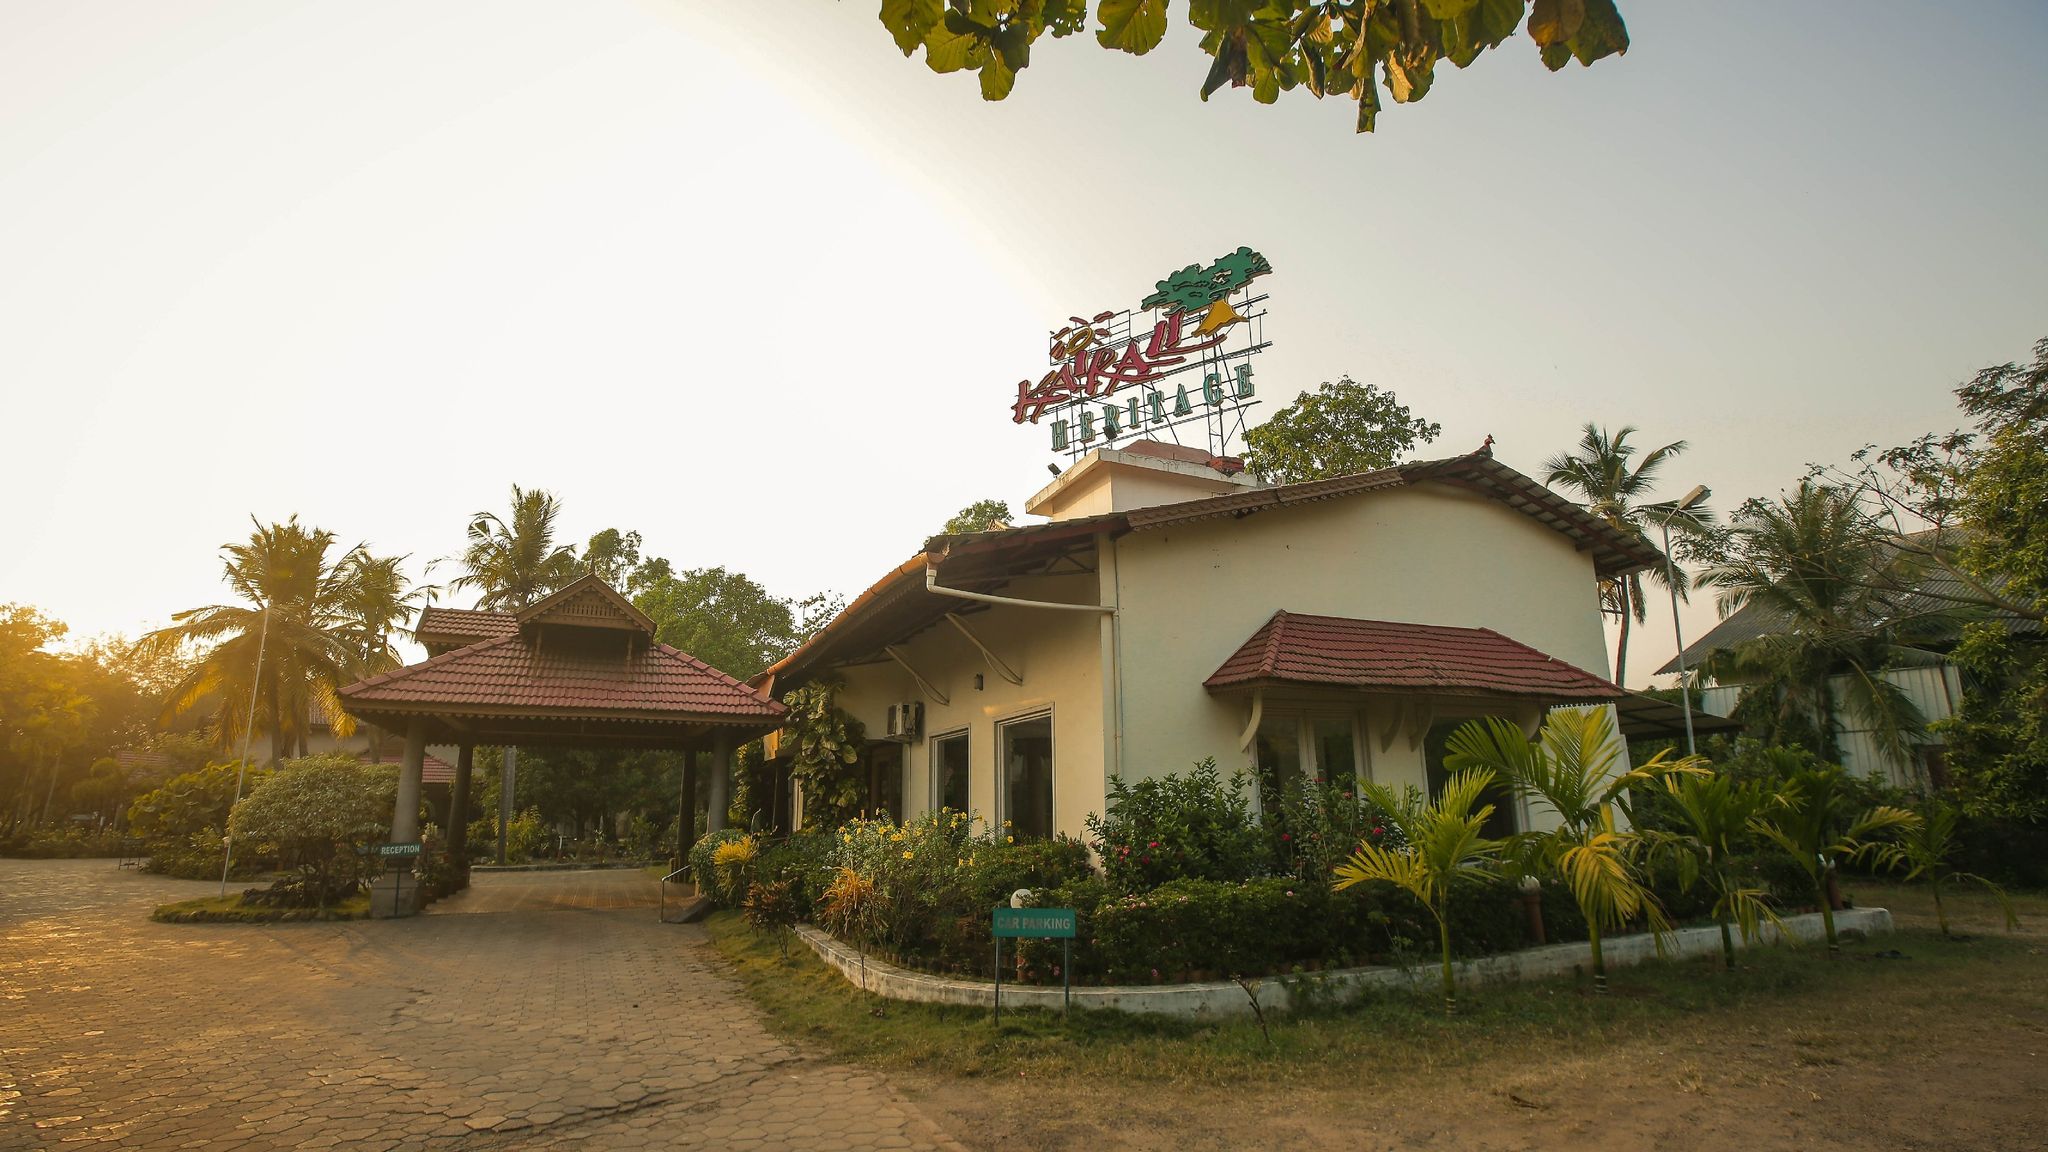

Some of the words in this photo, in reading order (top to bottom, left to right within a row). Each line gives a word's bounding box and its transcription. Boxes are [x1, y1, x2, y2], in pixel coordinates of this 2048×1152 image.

[1051, 363, 1255, 451] HERITAGE
[381, 844, 420, 855] RECEPTION
[997, 918, 1020, 929] CAR
[1023, 918, 1071, 929] PARKING
